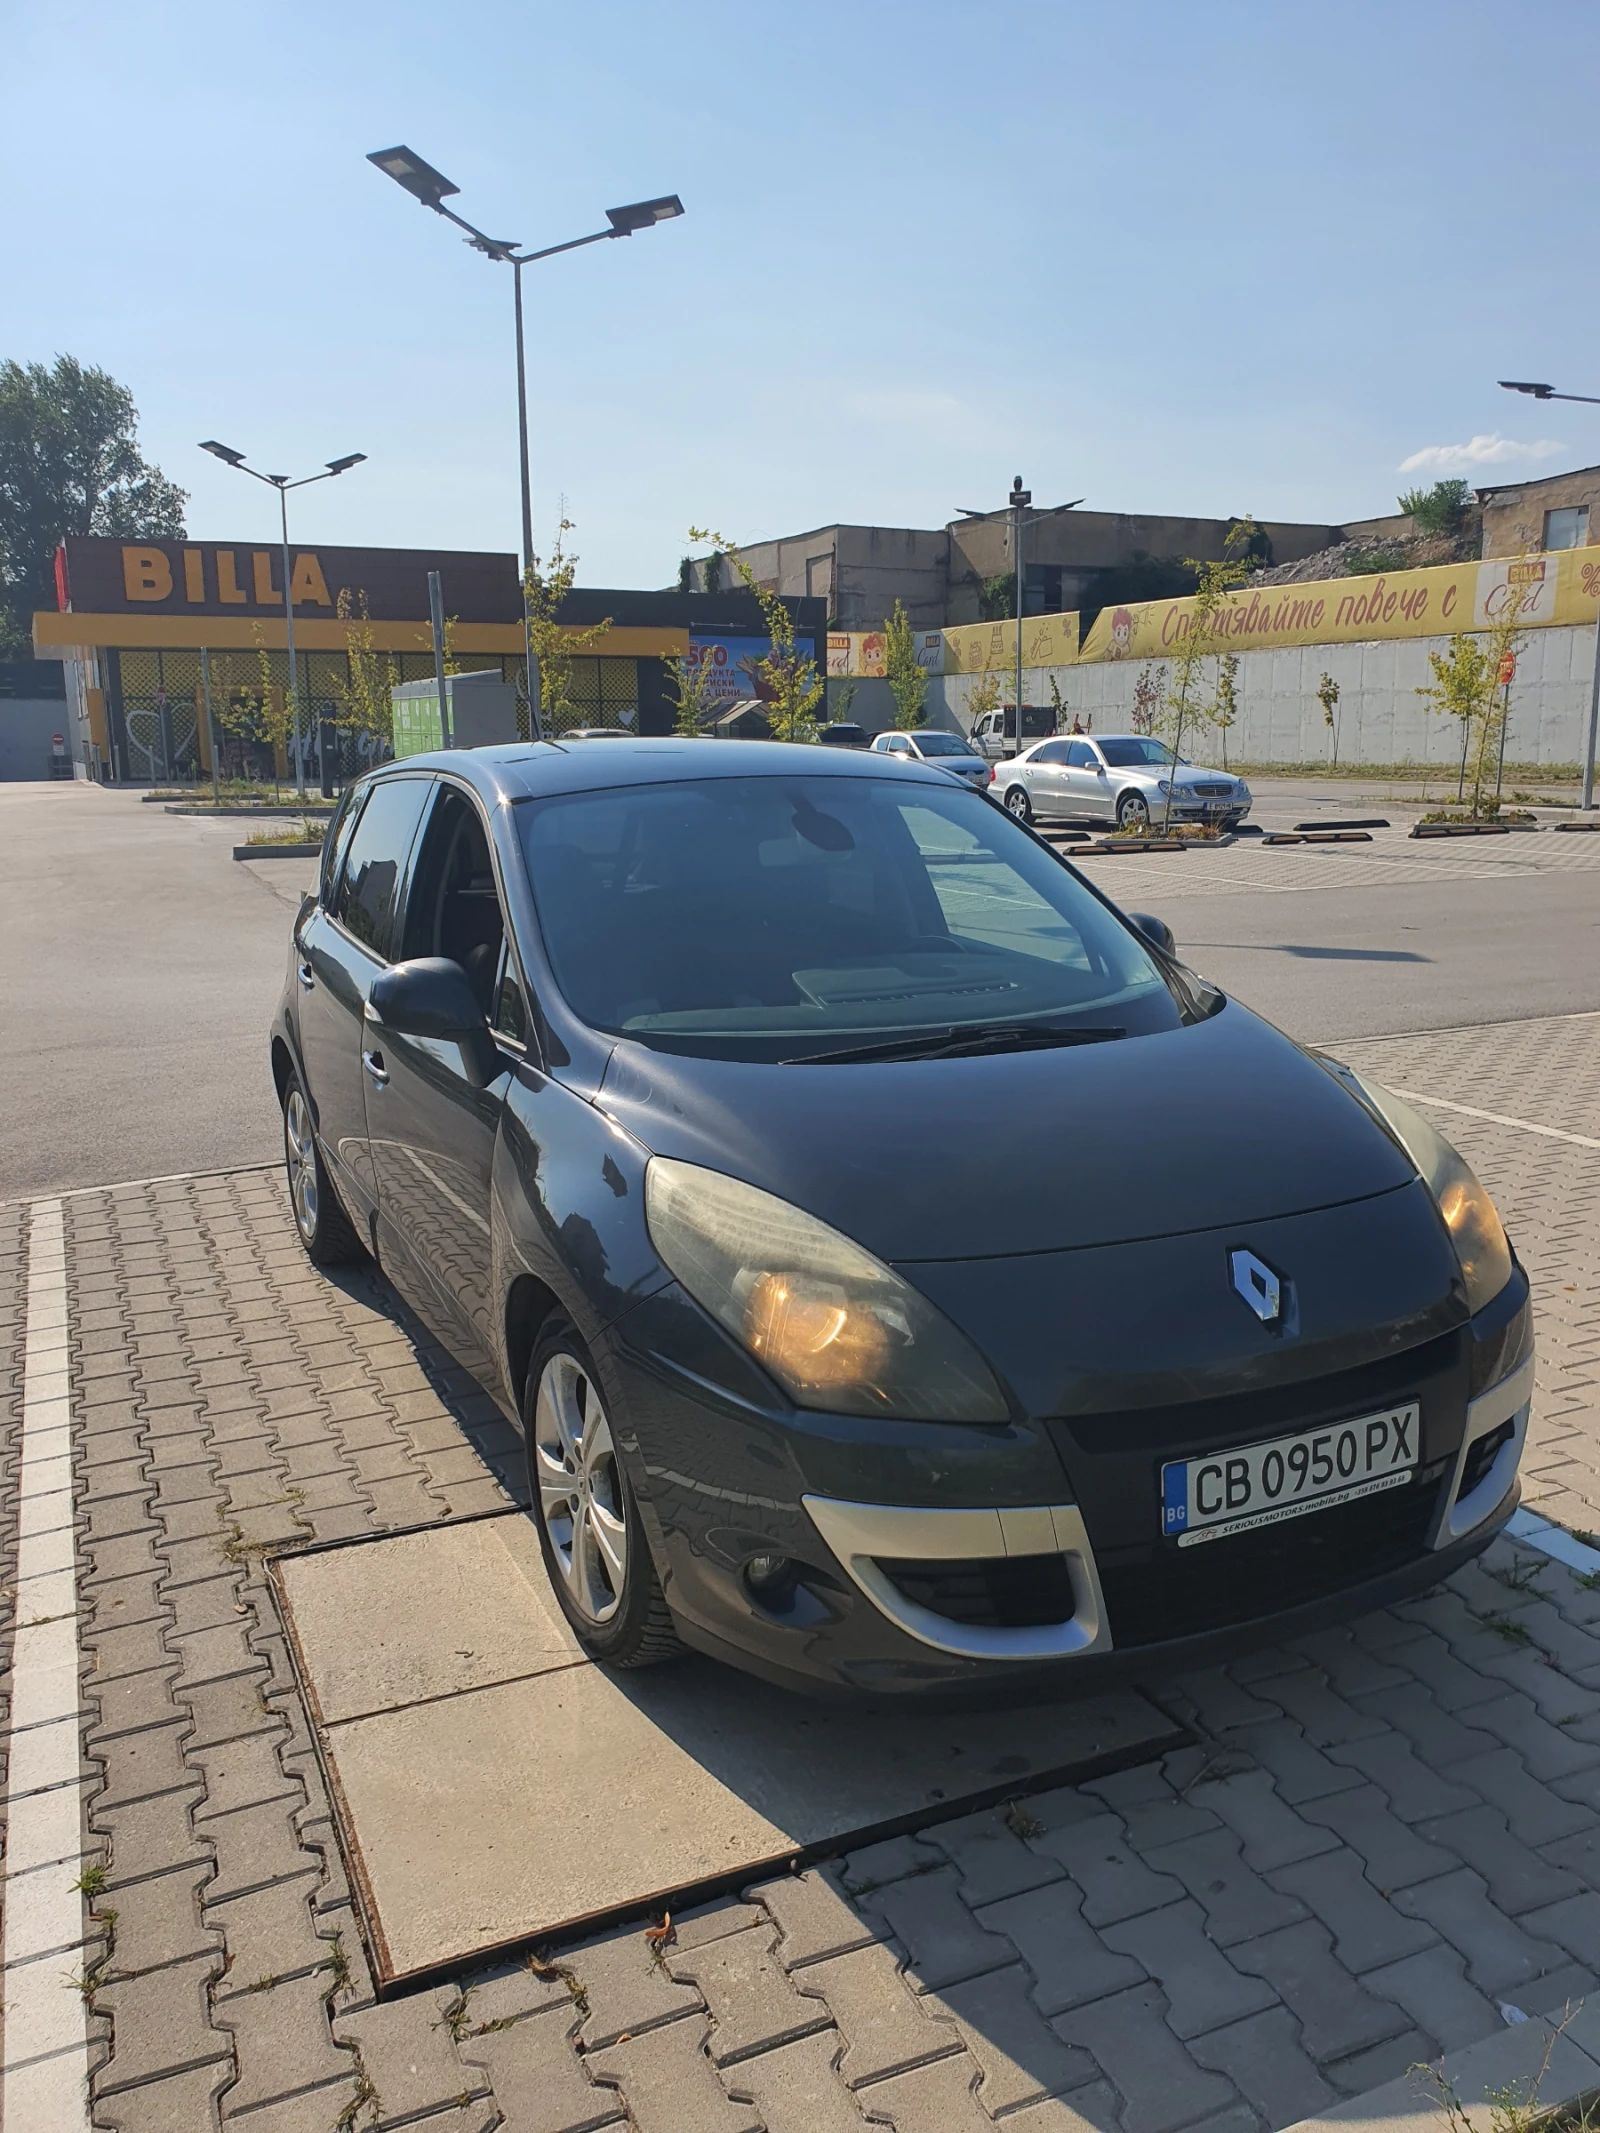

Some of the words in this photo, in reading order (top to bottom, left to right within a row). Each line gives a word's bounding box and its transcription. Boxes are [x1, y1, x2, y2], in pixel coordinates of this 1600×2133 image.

[122, 546, 332, 606] BILLA
[1335, 577, 1428, 627] повече
[1441, 584, 1457, 618] с
[685, 645, 728, 667] 500
[715, 688, 741, 697] ЦЕНИ
[1167, 1505, 1185, 1522] BG
[1196, 1458, 1251, 1515] CB
[1262, 1429, 1357, 1498] 0950
[1366, 1412, 1412, 1471] PX
[1222, 1492, 1350, 1534] SERIOUSMOTORS.mobile.bg
